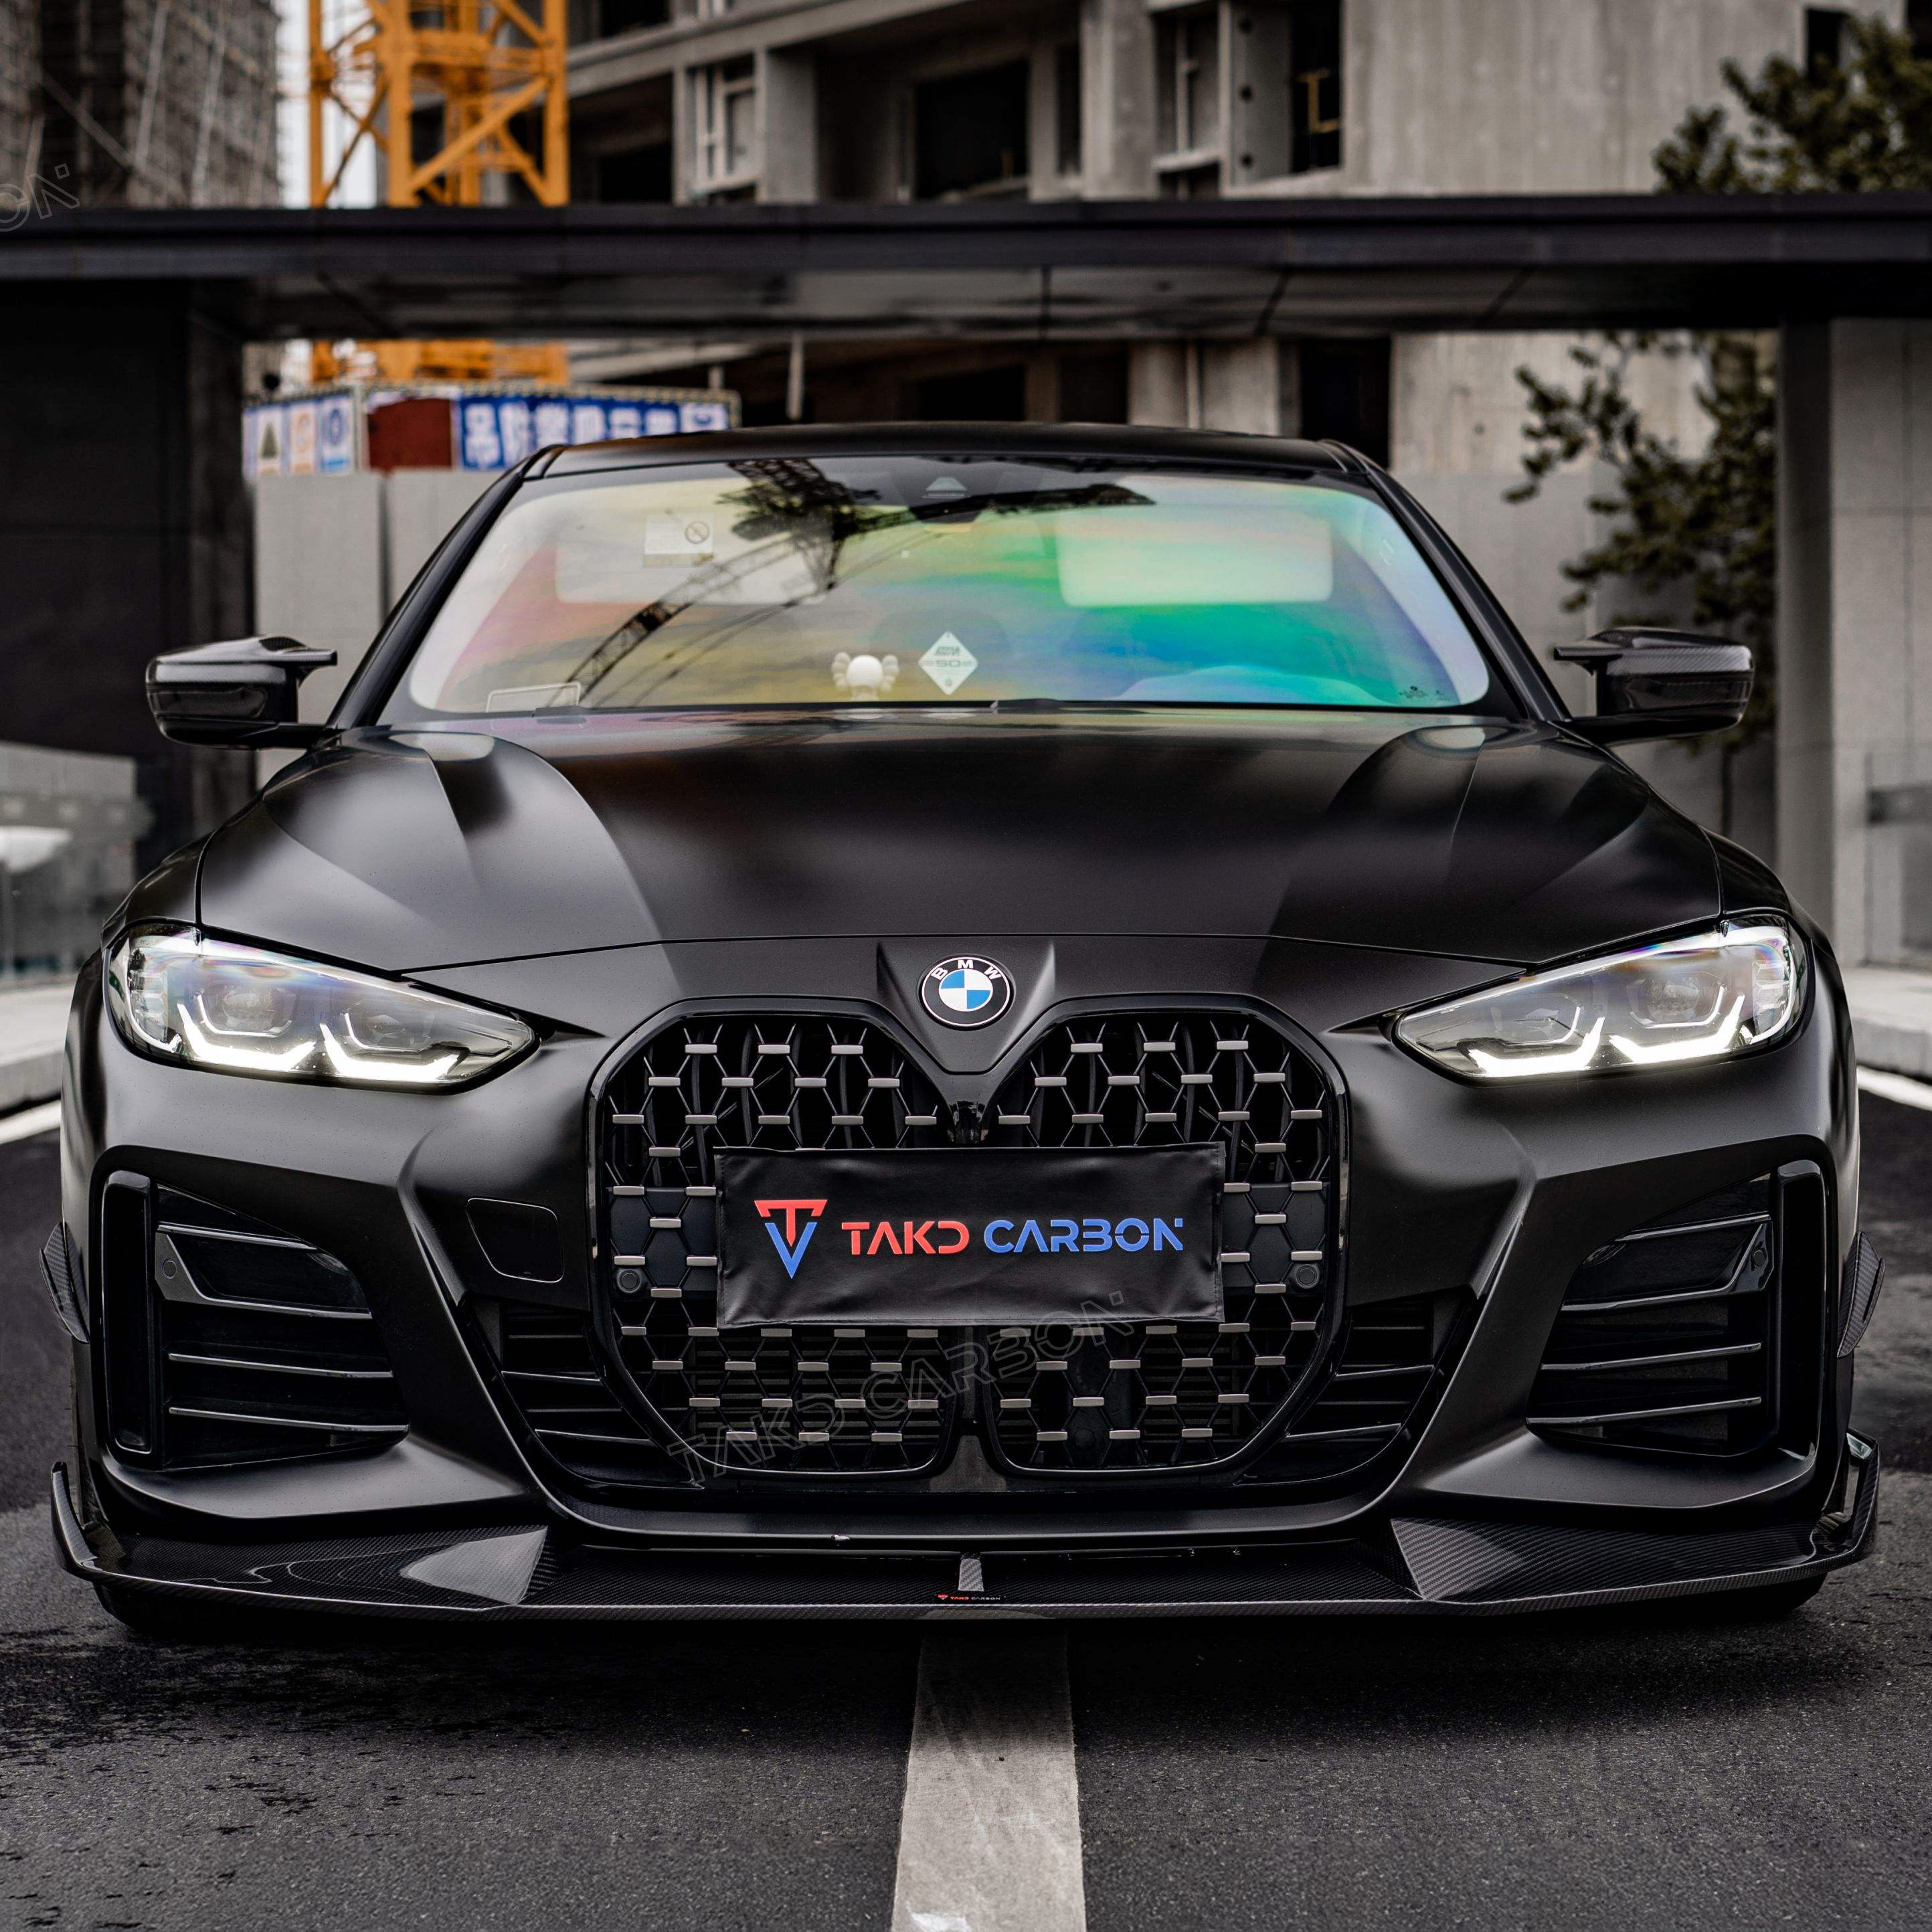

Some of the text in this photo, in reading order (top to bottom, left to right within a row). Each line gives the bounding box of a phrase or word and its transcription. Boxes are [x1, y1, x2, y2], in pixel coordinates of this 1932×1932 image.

[931, 959, 1002, 980] BMW
[841, 1218, 1183, 1255] TAKD CARBON
